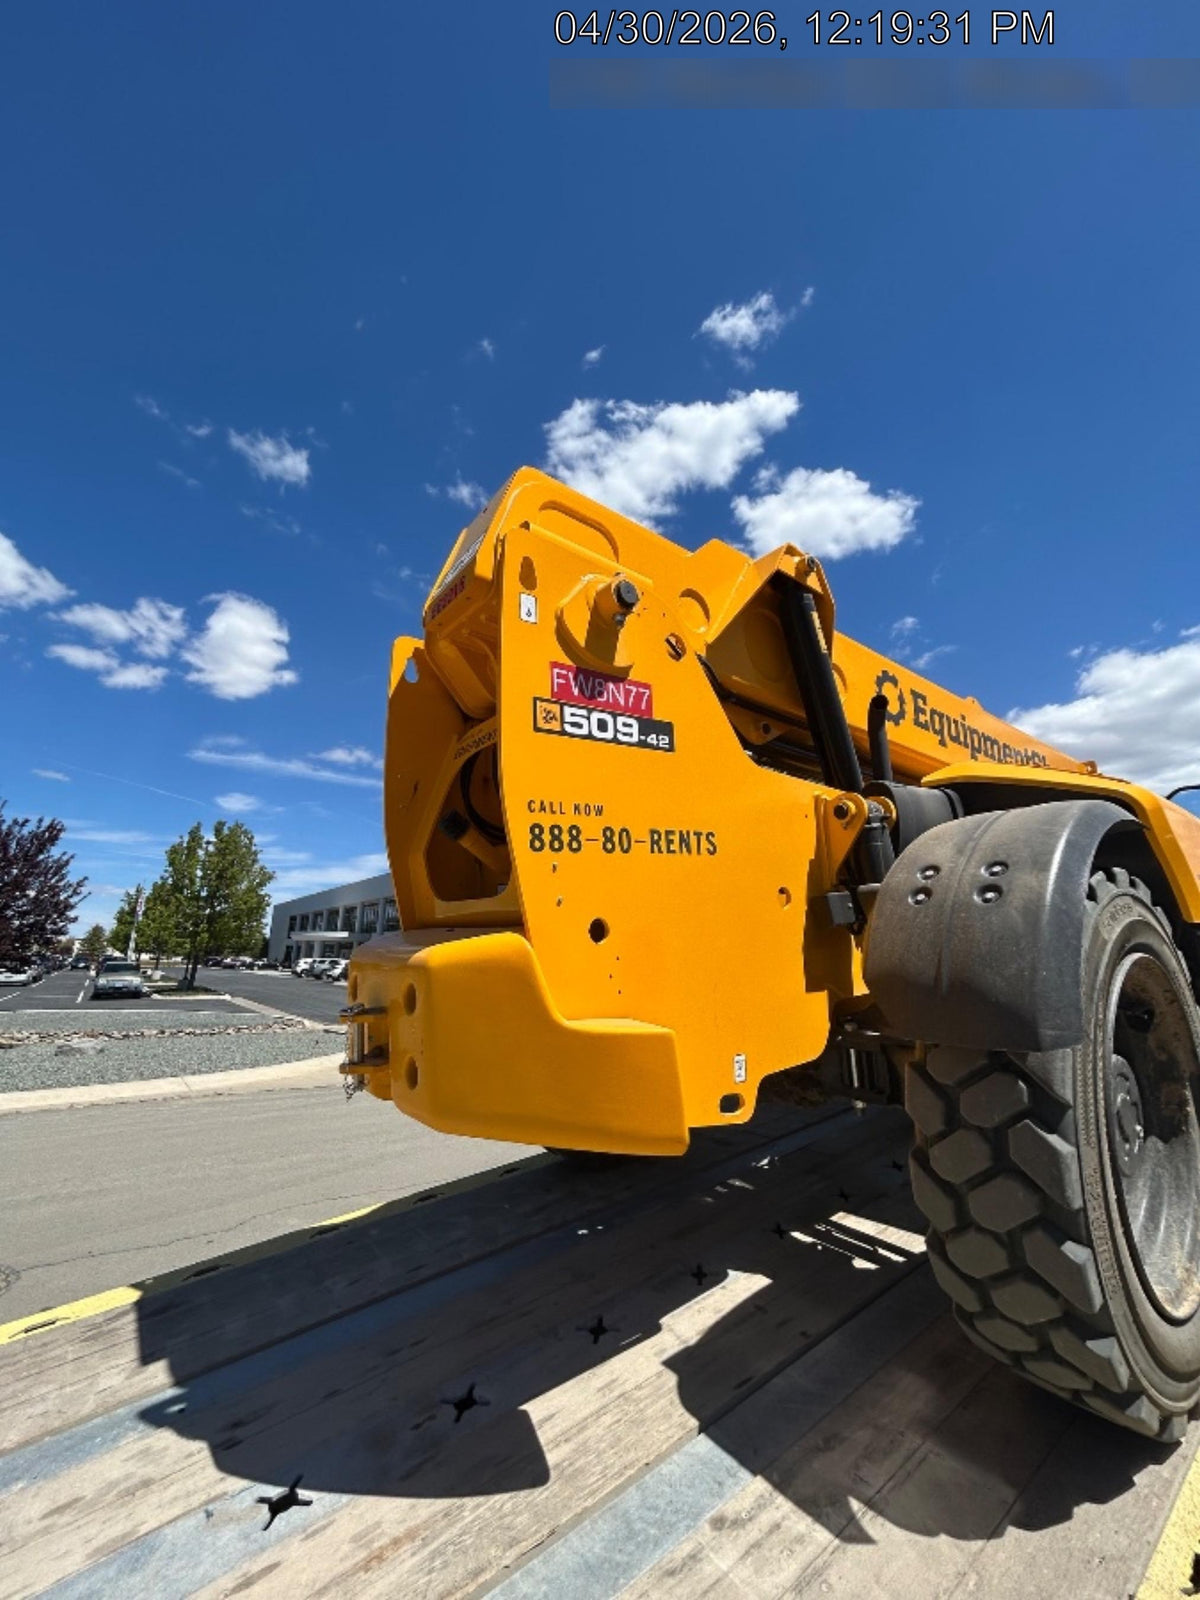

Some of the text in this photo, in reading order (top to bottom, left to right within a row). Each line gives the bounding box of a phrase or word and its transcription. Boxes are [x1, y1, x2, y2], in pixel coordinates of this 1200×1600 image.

[552, 667, 650, 710] FW8N77
[563, 705, 670, 748] 509-42
[527, 799, 604, 817] CALL NOW
[528, 822, 718, 856] 888-80-RENTS
